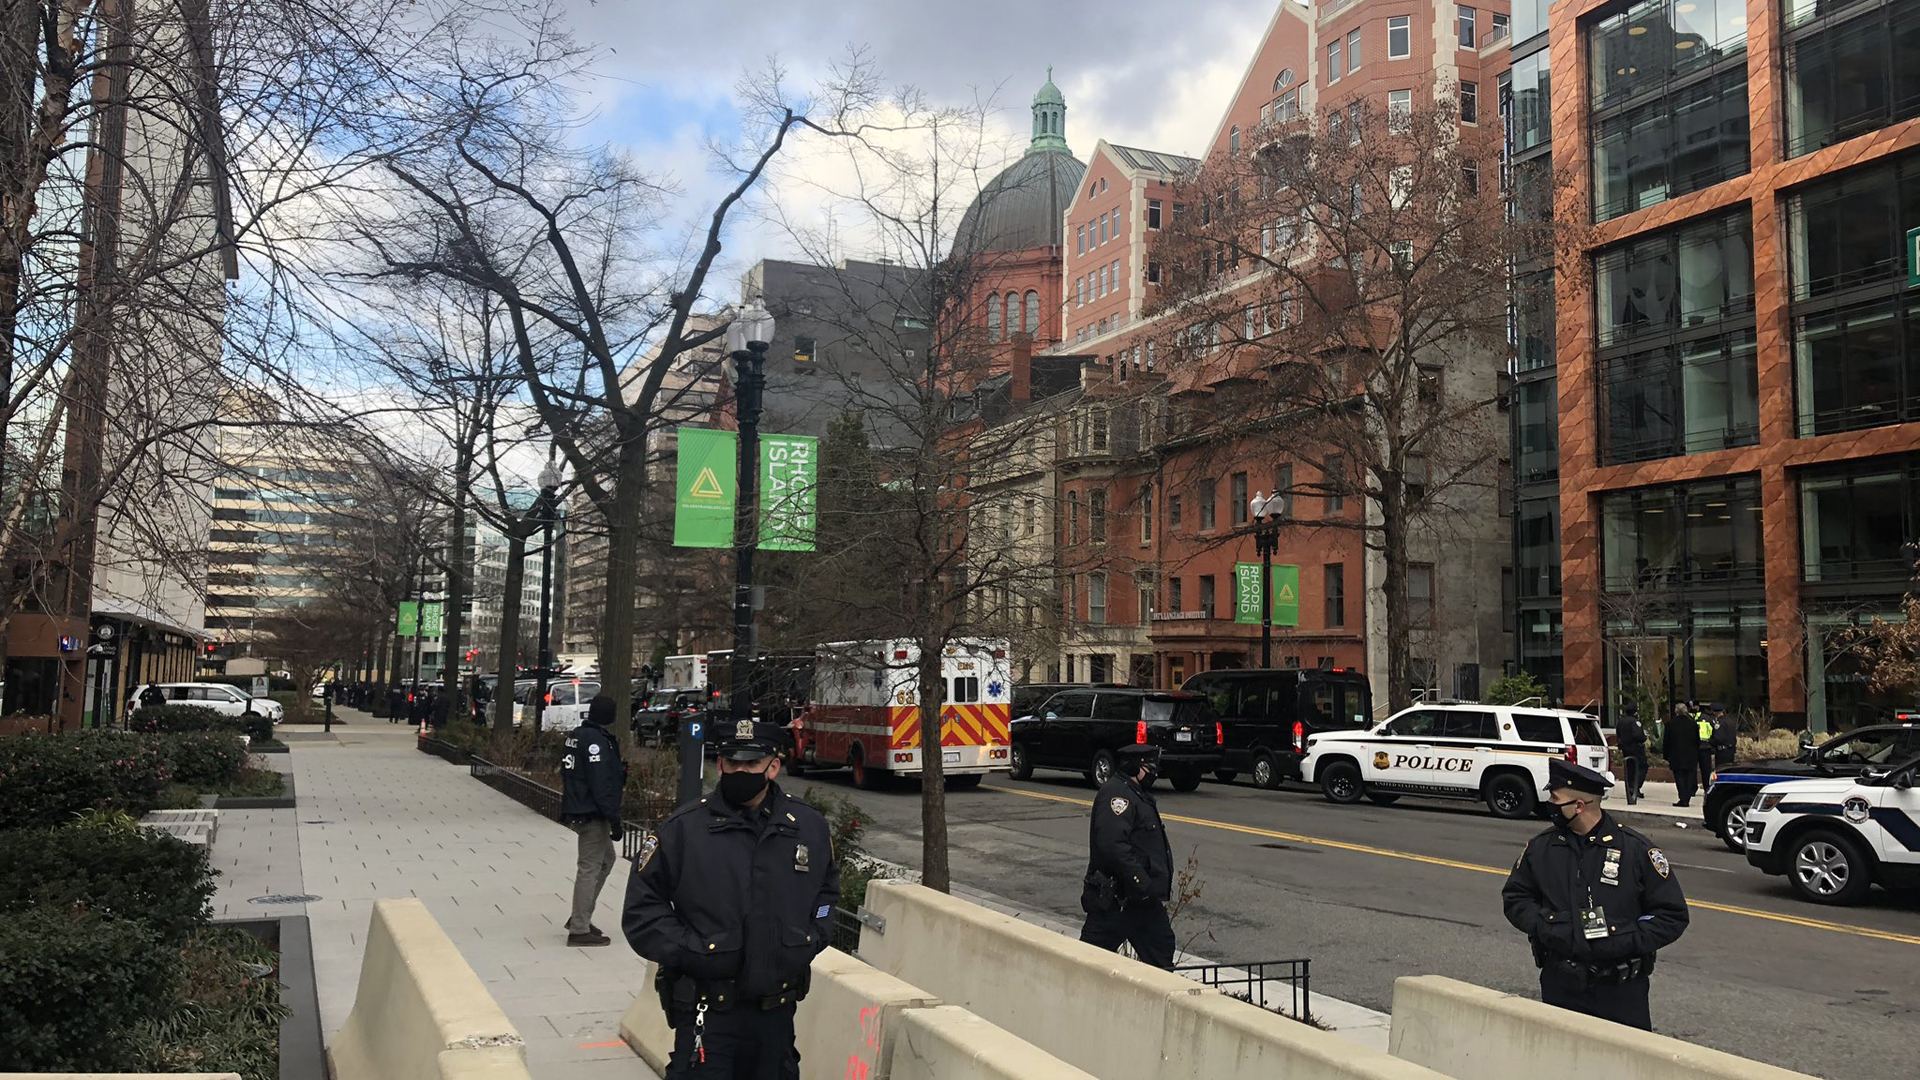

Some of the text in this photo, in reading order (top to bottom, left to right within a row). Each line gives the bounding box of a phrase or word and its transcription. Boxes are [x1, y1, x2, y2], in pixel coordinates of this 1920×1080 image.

[769, 441, 788, 531] ISLAND
[790, 442, 809, 528] RHODE
[1240, 565, 1250, 613] ISLAND
[1250, 566, 1260, 613] RHODE
[957, 662, 975, 670] EMS
[692, 723, 701, 736] P
[1394, 754, 1474, 773] POLICE
